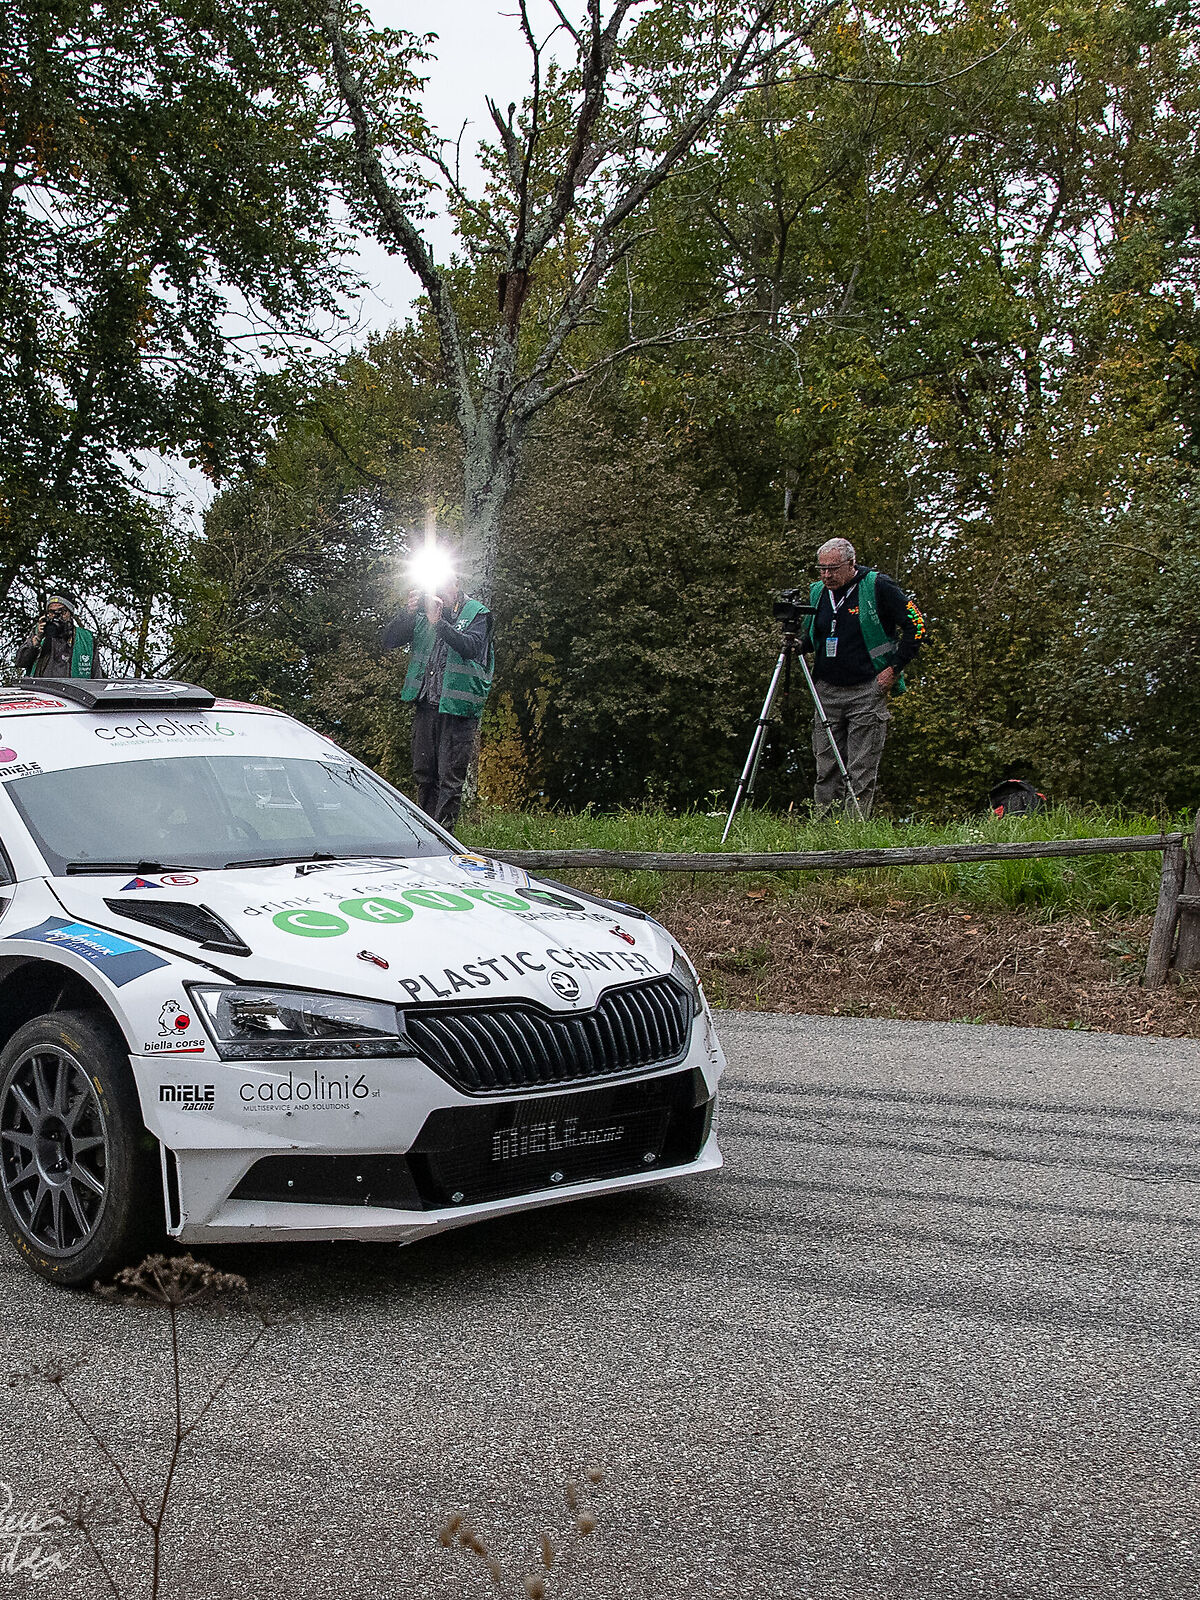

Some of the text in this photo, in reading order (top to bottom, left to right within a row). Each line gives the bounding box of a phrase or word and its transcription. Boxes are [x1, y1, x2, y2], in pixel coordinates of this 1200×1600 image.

[94, 716, 236, 740] cadolini6
[243, 879, 490, 917] drink & restaurant
[398, 949, 660, 1003] PLASTIC CENTER
[144, 1038, 206, 1052] biella corse
[239, 1070, 381, 1101] cadolini6 srl
[243, 1104, 292, 1112] MULTISERVICE
[312, 1102, 351, 1110] SOLUTIONS
